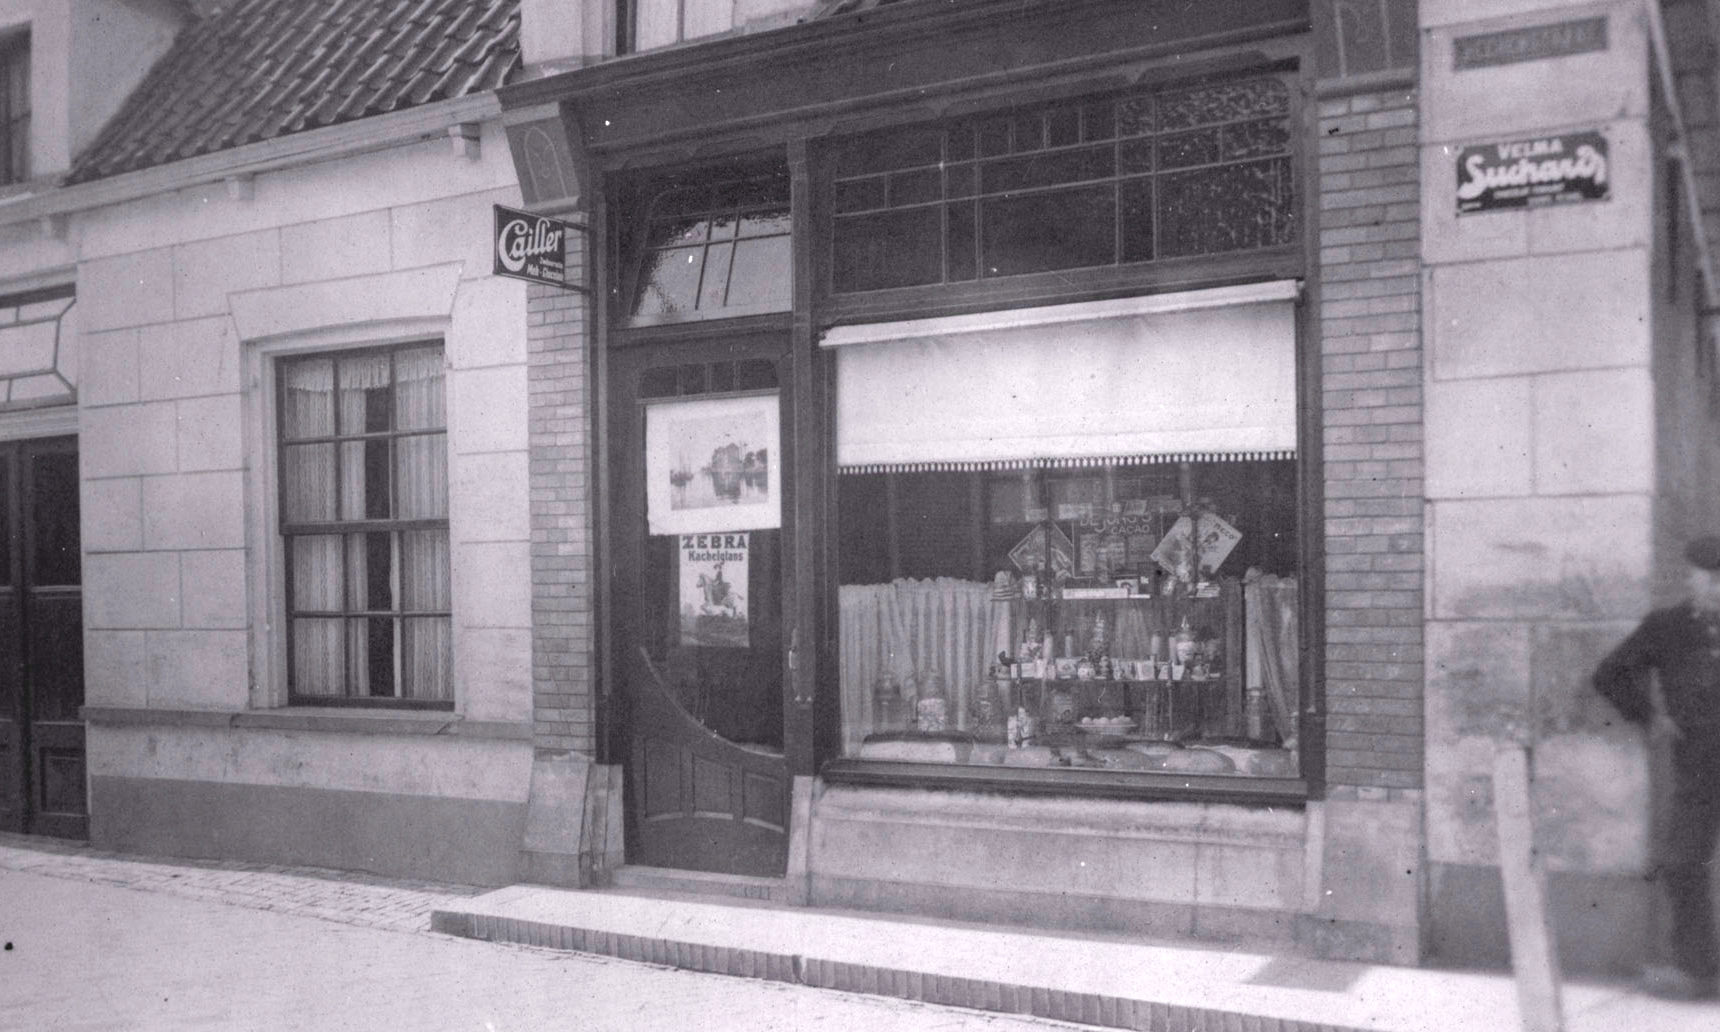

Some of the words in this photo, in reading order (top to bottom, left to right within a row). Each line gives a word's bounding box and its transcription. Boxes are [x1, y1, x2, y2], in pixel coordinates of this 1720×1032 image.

[1458, 145, 1606, 199] Suchard
[499, 217, 562, 272] Cailler
[1111, 524, 1150, 535] CACAO
[682, 535, 747, 549] ZEBRA
[689, 550, 744, 562] Kachelglans
